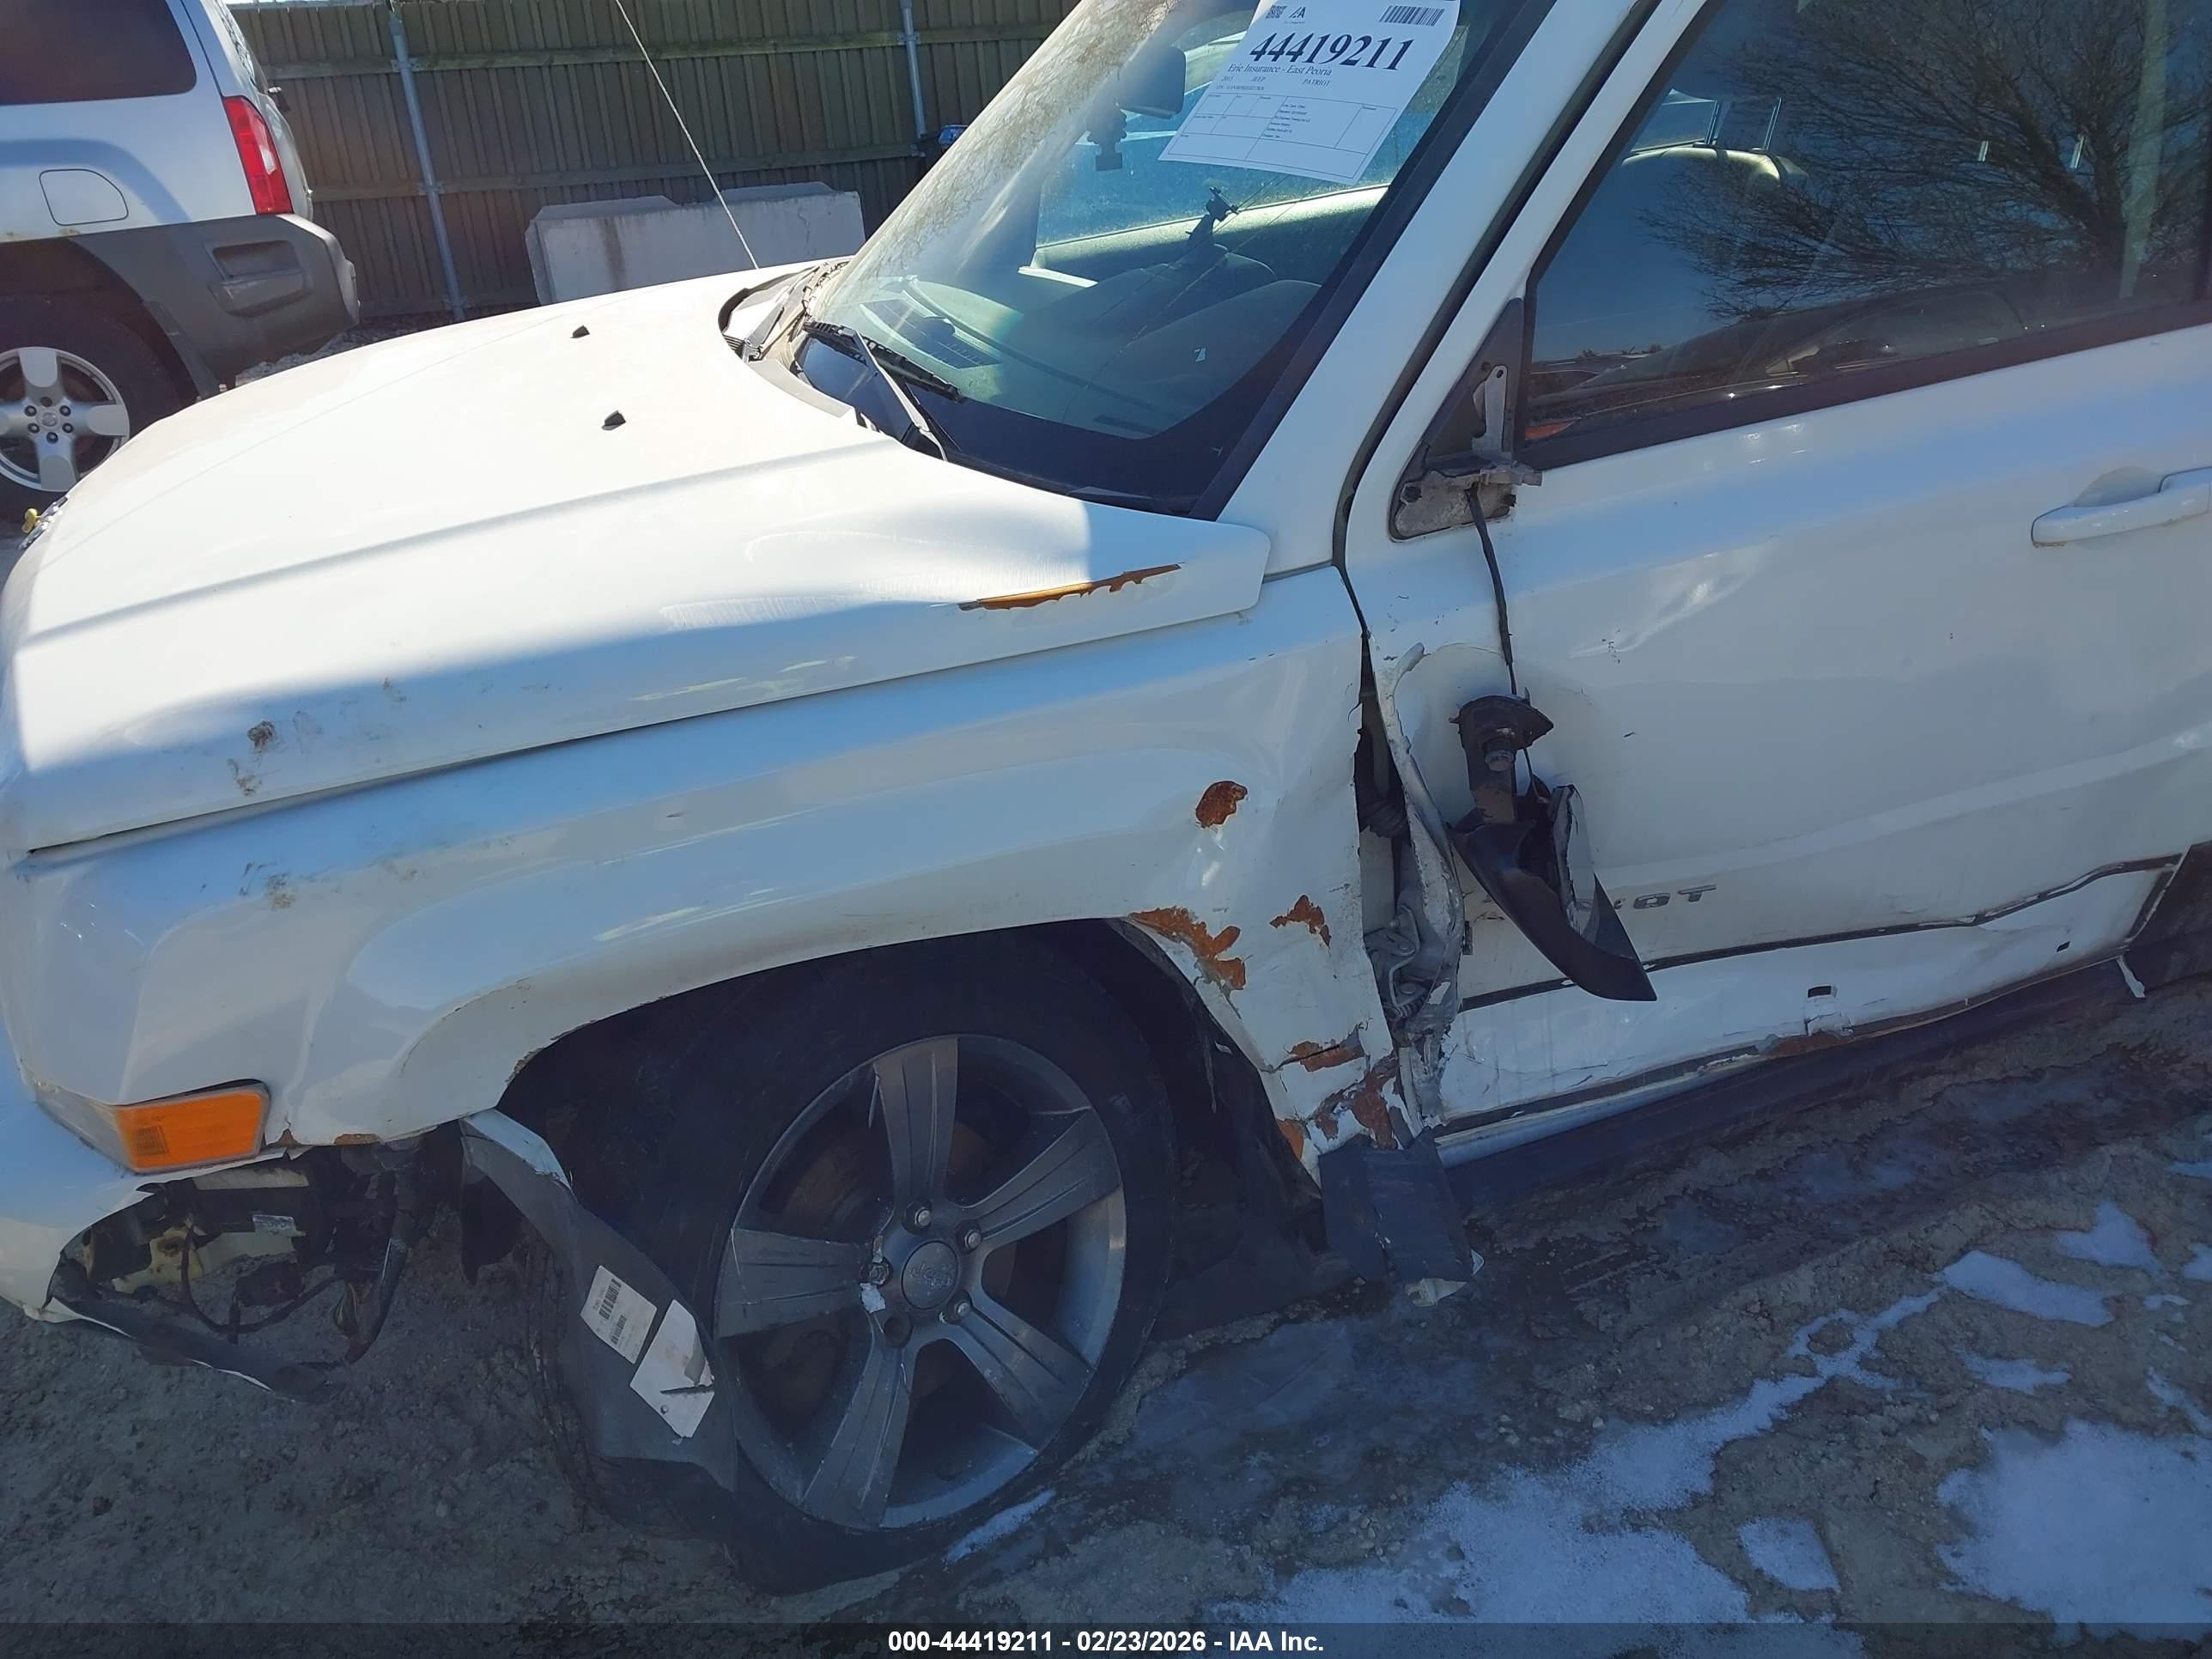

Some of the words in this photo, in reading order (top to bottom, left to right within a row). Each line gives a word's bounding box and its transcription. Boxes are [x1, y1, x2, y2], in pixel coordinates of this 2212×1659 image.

[1249, 32, 1415, 70] 44419211
[1228, 64, 1243, 72] Erie
[1244, 64, 1281, 73] Insurance
[1287, 65, 1305, 74] East
[1305, 65, 1333, 76] Peoria
